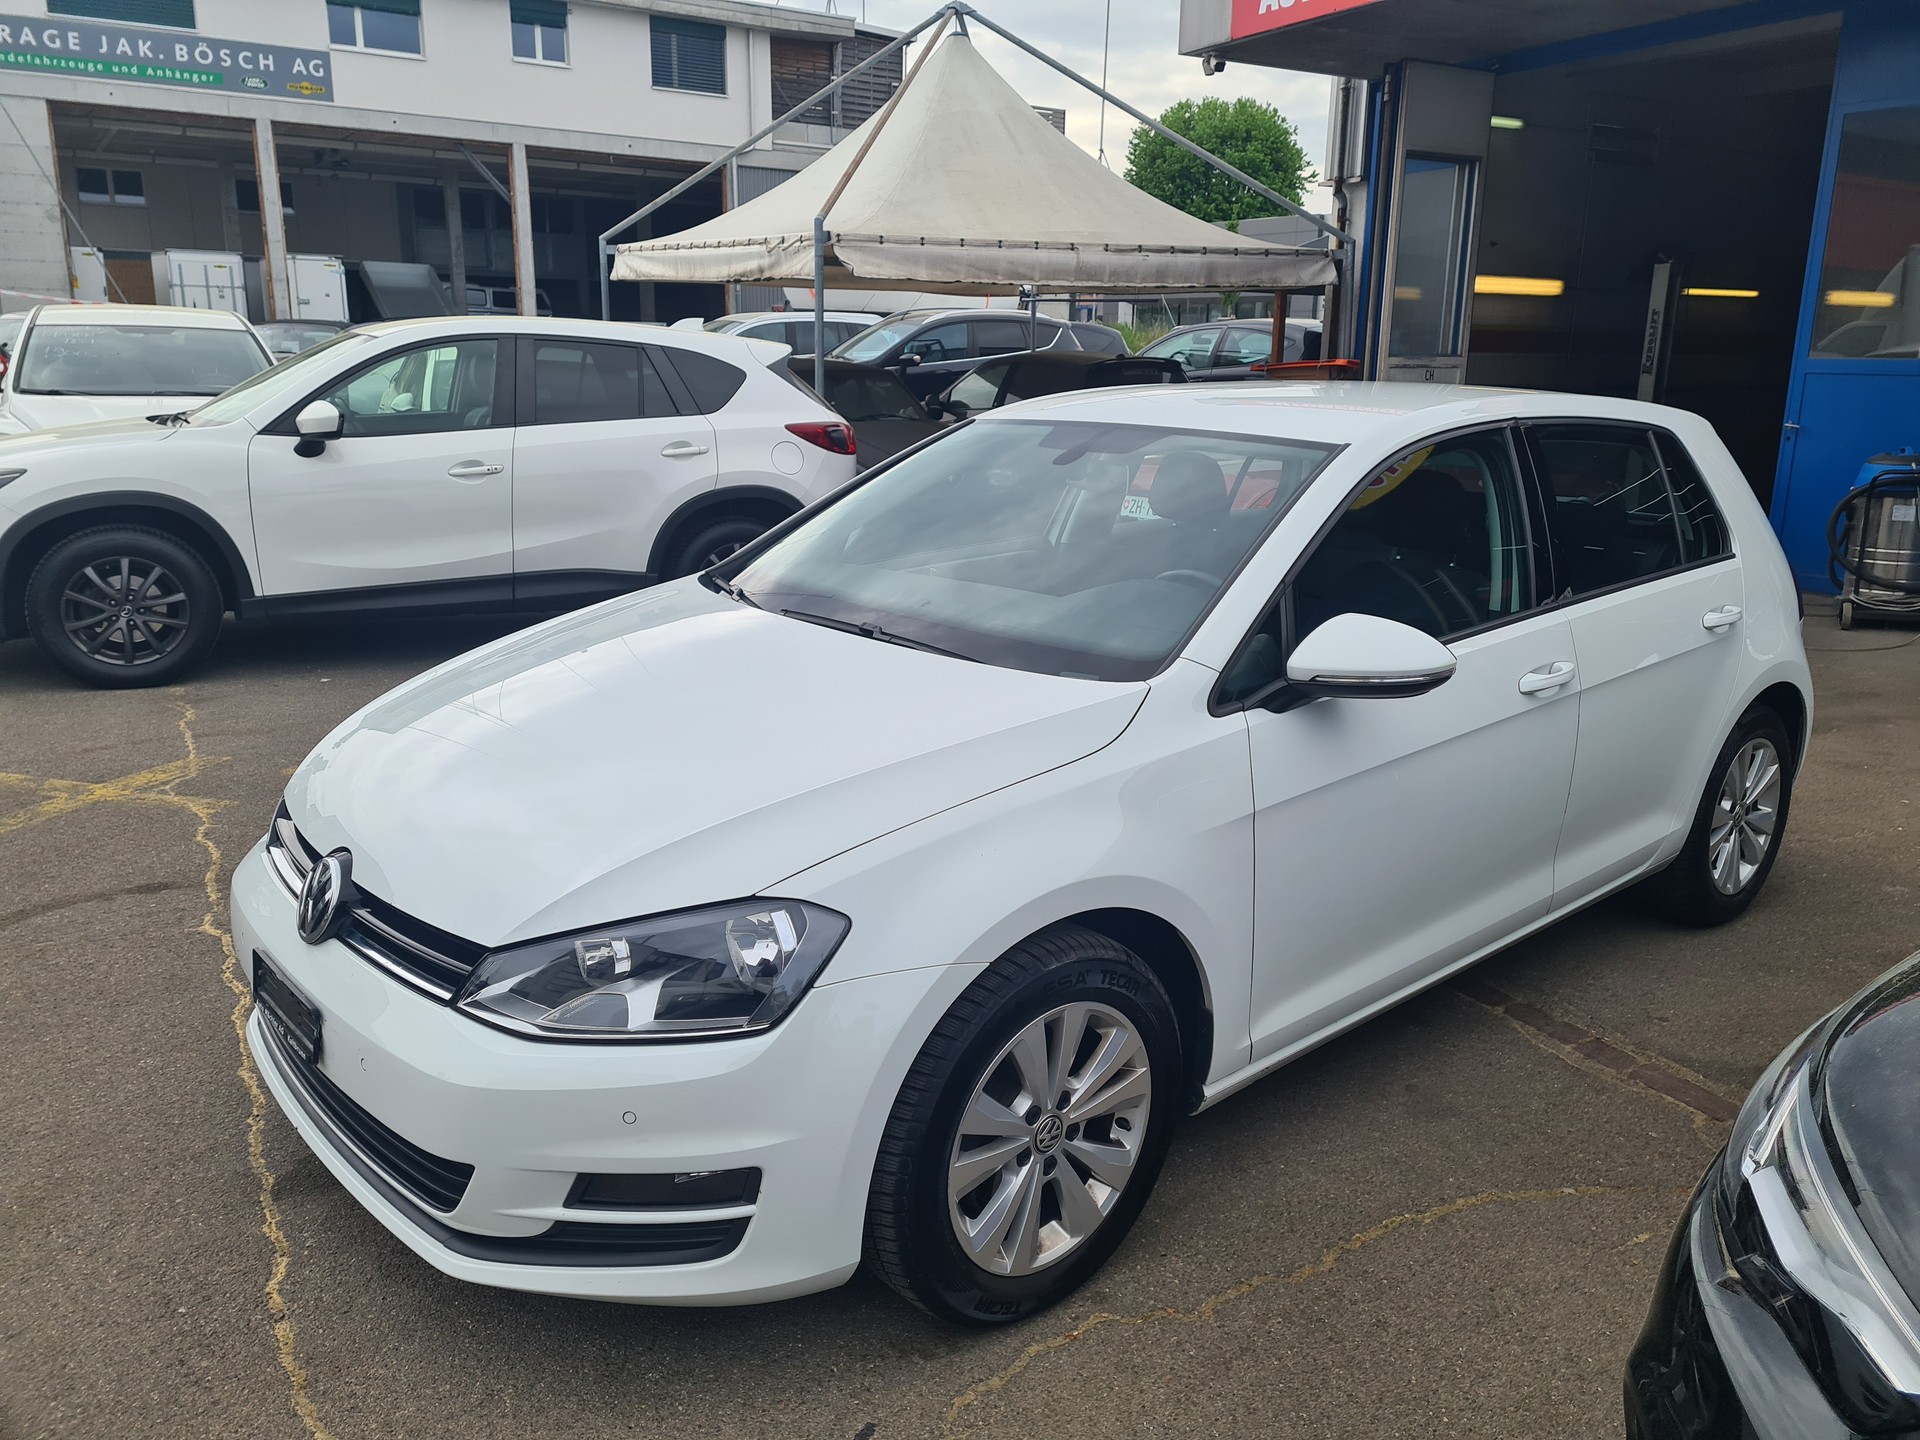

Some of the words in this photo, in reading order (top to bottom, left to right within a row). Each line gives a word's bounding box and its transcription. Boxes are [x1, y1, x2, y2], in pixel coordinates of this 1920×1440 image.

[0, 24, 81, 51] RAGE
[98, 35, 164, 60] JAK.
[174, 42, 275, 72] BÖSCH
[292, 57, 325, 77] AG
[112, 64, 138, 75] und
[146, 67, 214, 84] Anhänger
[1424, 369, 1435, 381] CH
